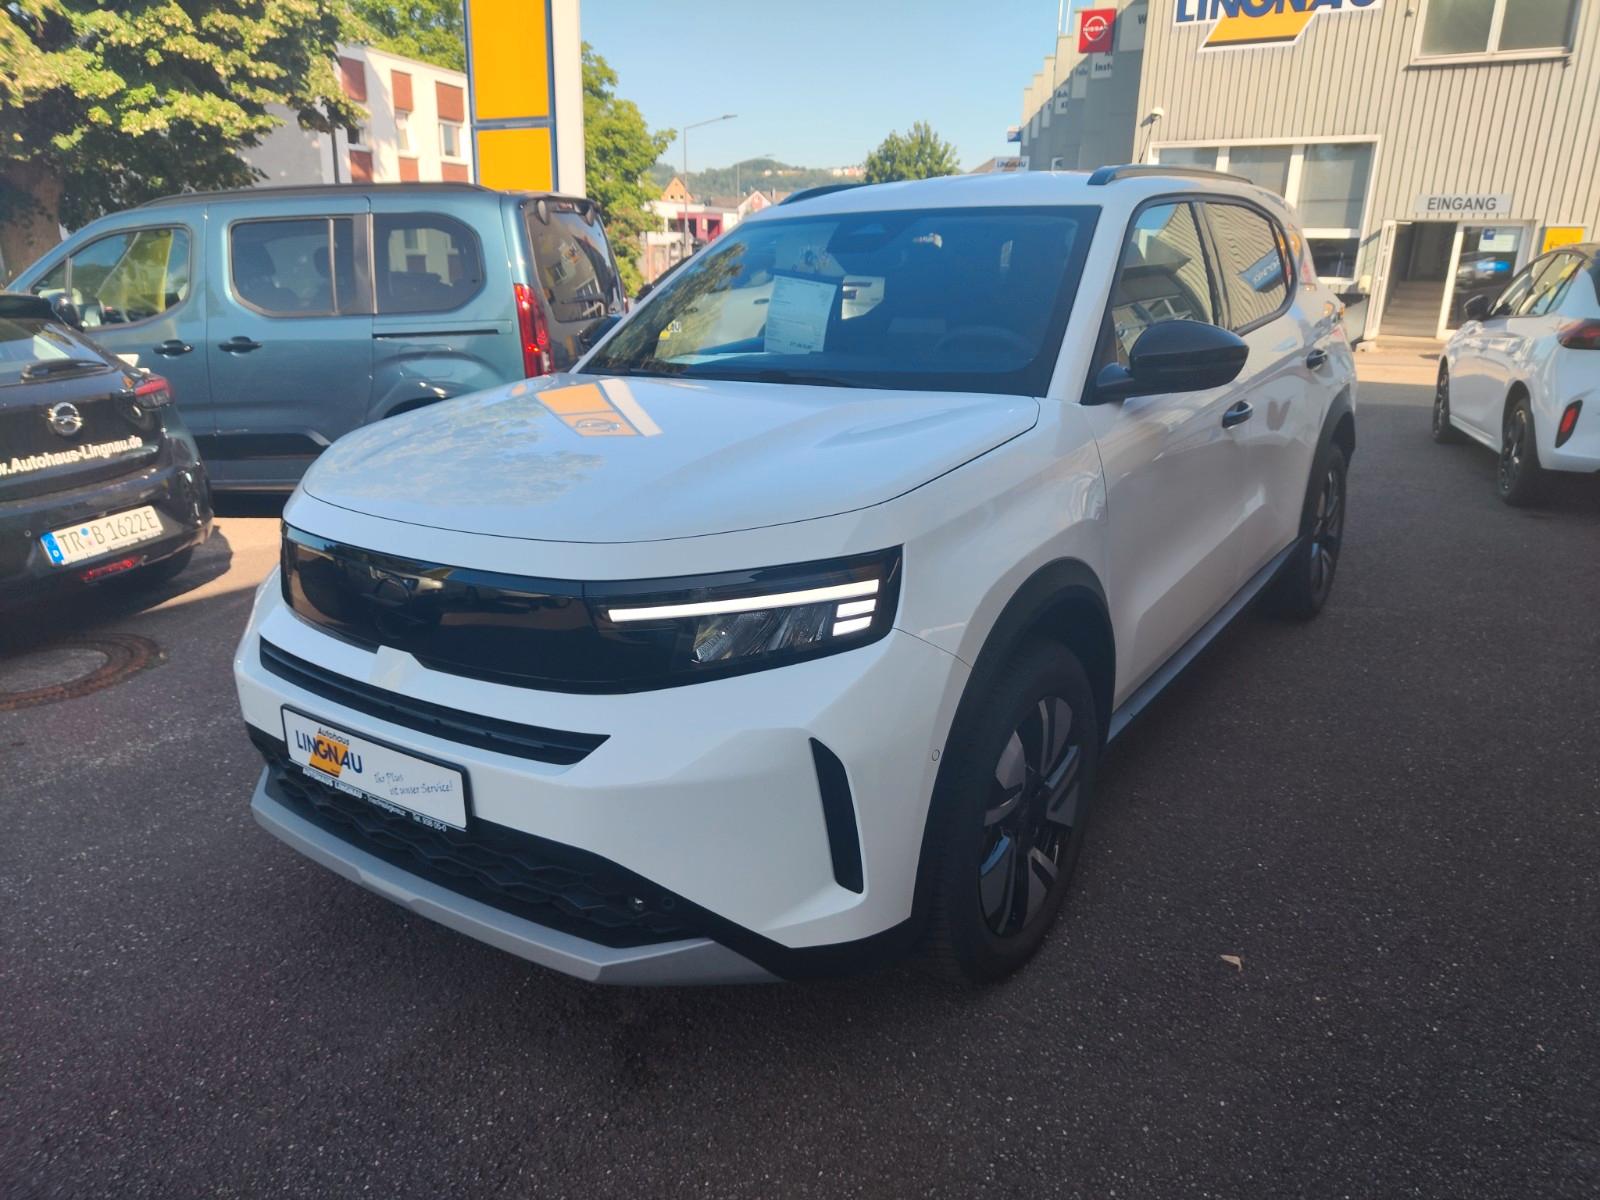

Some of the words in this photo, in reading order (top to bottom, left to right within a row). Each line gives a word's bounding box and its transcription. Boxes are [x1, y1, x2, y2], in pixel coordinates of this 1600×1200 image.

[1427, 197, 1497, 211] EINGANG
[58, 530, 85, 555] TR
[90, 522, 105, 545] B
[106, 510, 158, 541] 1622E
[295, 729, 363, 774] LINGNAU
[318, 727, 350, 746] Autohaus
